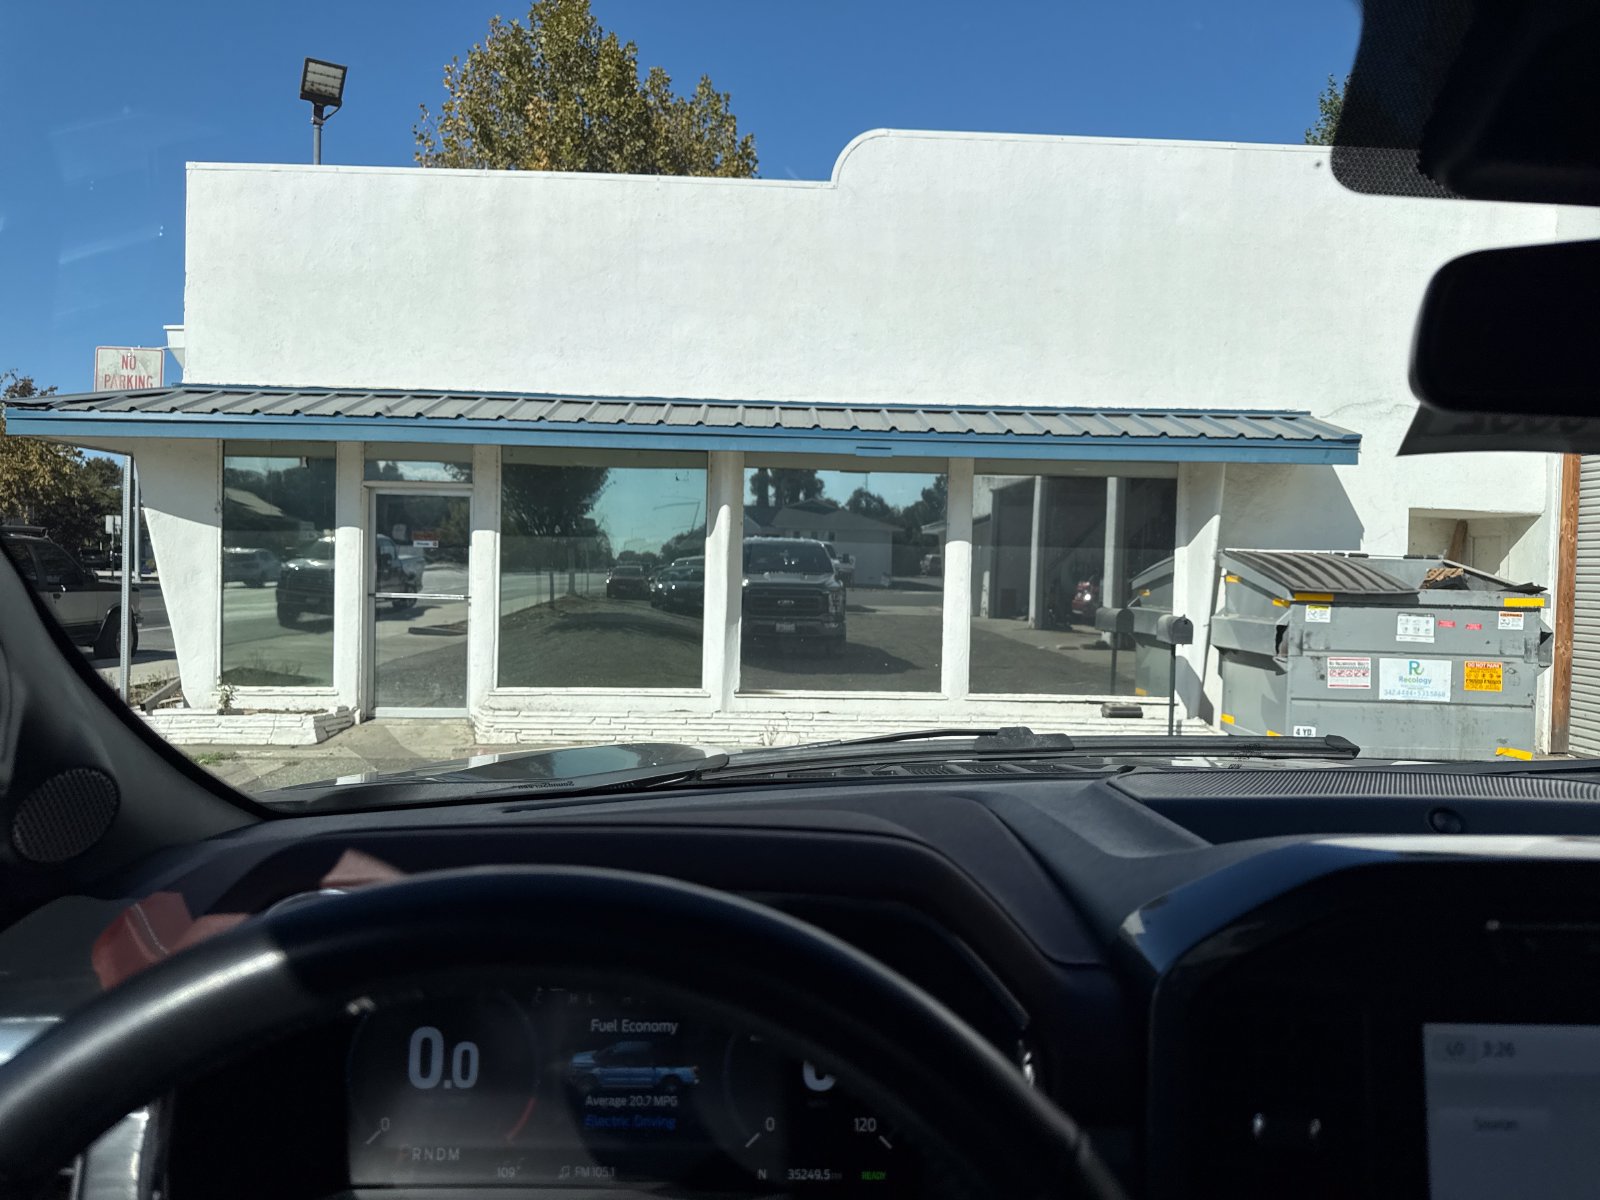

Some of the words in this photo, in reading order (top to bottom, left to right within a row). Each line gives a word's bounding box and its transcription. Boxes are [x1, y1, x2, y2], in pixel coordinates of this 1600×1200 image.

[121, 354, 137, 370] NO
[104, 373, 153, 389] PARKING
[1398, 675, 1432, 685] Recology
[1296, 728, 1301, 736] 4
[590, 1018, 618, 1033] Fuel
[621, 1019, 679, 1036] Economy
[408, 1025, 480, 1090] 0.0
[585, 1096, 627, 1108] Average
[629, 1095, 651, 1107] 20.7
[653, 1096, 679, 1107] MPG
[380, 1117, 391, 1132] 0
[765, 1116, 776, 1132] 0
[853, 1117, 878, 1133] 120
[574, 1166, 590, 1177] FM
[756, 1168, 768, 1180] N
